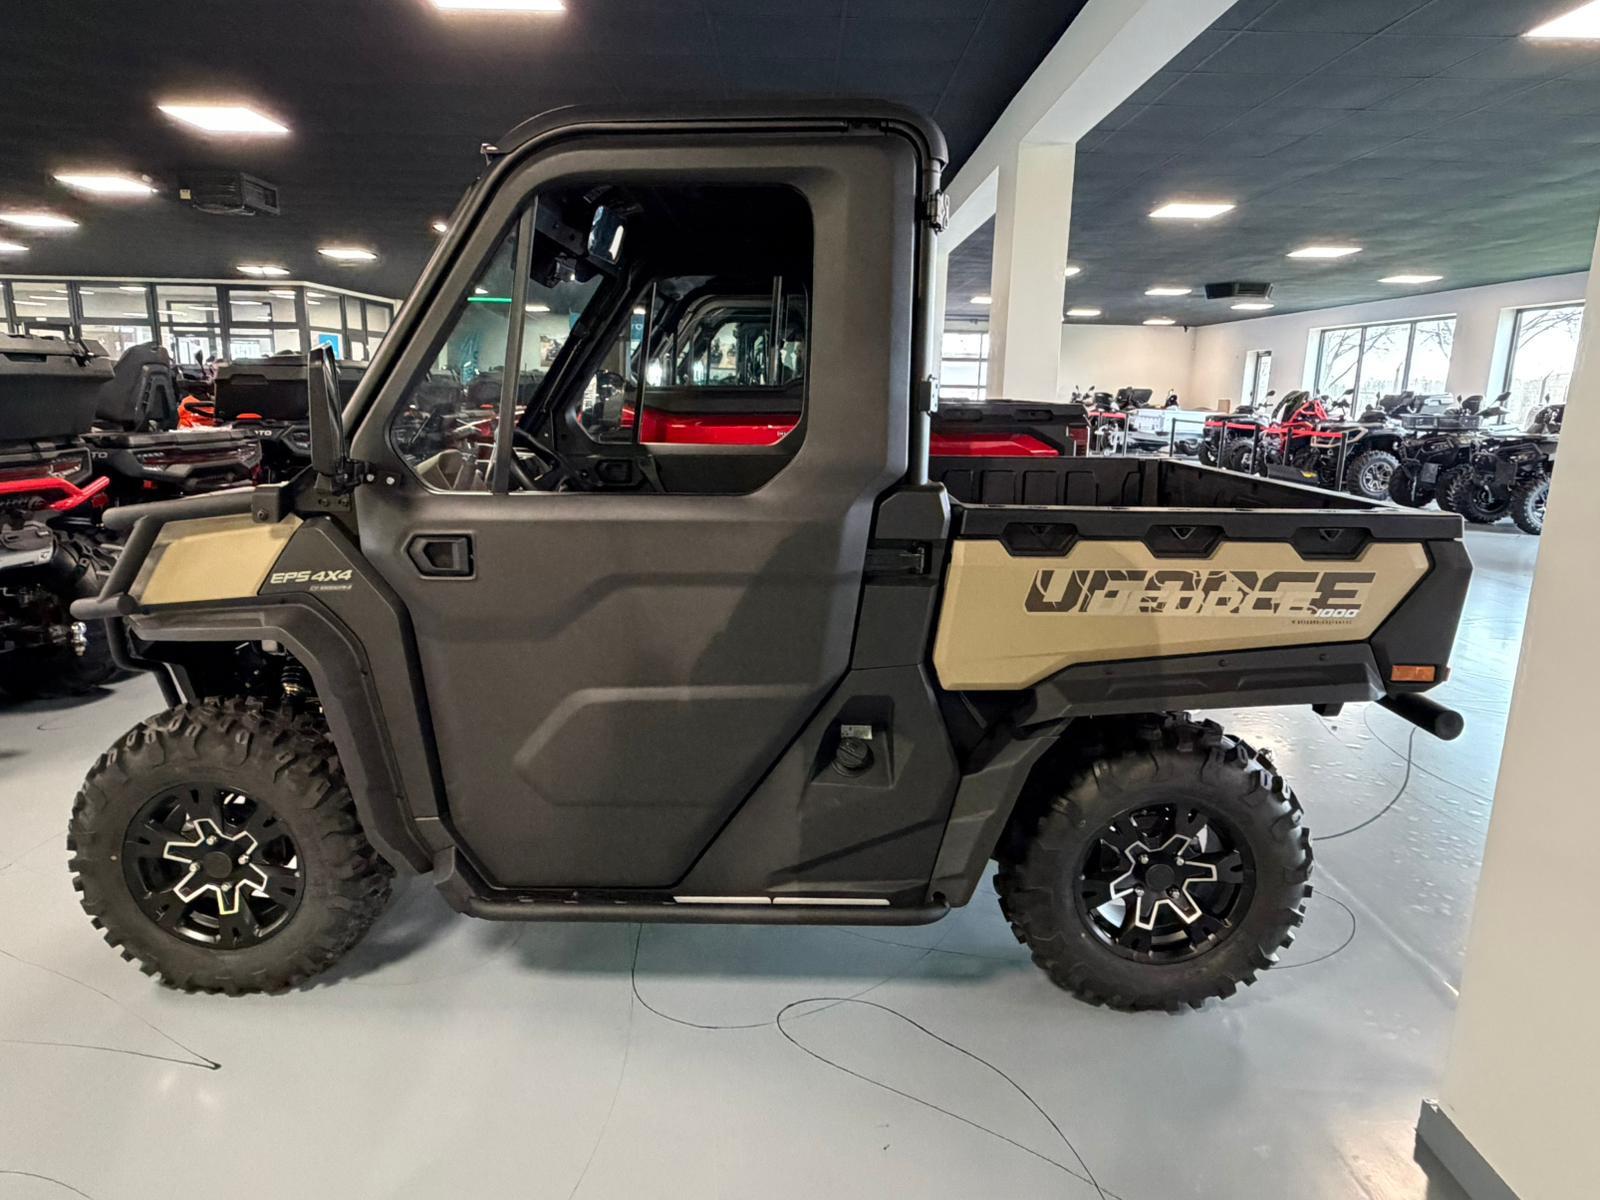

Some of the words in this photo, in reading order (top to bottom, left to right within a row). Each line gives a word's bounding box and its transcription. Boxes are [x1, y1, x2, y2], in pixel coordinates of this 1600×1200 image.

[270, 571, 311, 584] EPS
[311, 569, 353, 582] 4X4
[1024, 569, 1376, 613] UFORCE
[1314, 608, 1360, 618] 1000
